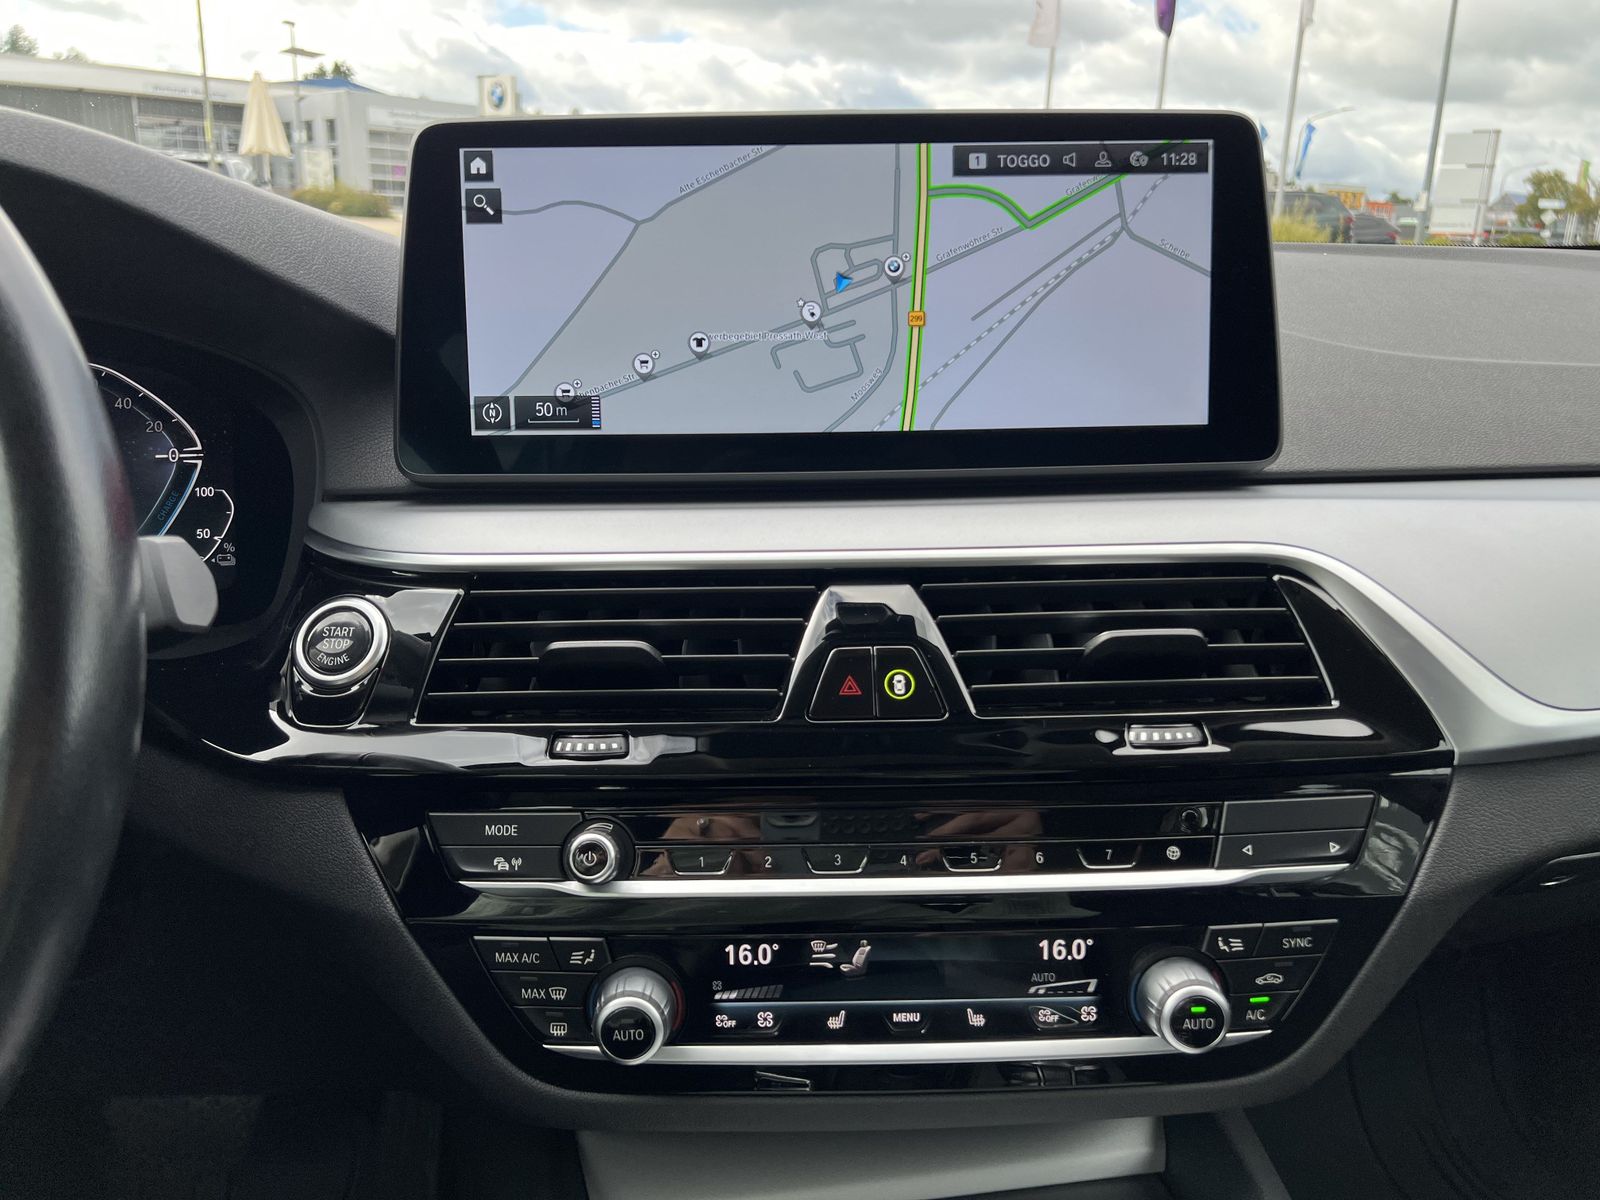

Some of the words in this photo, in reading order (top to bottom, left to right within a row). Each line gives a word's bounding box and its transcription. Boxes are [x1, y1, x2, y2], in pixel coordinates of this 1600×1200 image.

[997, 154, 1050, 168] TOGGO
[1160, 152, 1198, 166] 11:28
[679, 182, 695, 194] Alte
[695, 152, 751, 185] Eschenbacher
[1160, 238, 1191, 259] Scheibe
[909, 314, 923, 323] 299
[763, 331, 802, 341] Pressath
[850, 367, 883, 402] Moosweg
[114, 397, 132, 410] 40
[535, 402, 553, 416] 50
[555, 405, 568, 416] m
[488, 408, 497, 418] N
[145, 420, 163, 433] 20
[168, 448, 179, 463] 0
[194, 486, 215, 498] 100
[196, 528, 211, 540] 50
[322, 626, 356, 637] START
[322, 638, 351, 650] STOP
[316, 652, 351, 666] ENGINE
[484, 824, 518, 836] MODE
[834, 854, 842, 866] 3
[899, 855, 908, 867] 4
[969, 852, 978, 865] 5
[1035, 851, 1045, 865] 6
[1105, 849, 1113, 861] 7
[698, 856, 705, 868] 1
[764, 856, 773, 868] 2
[1282, 937, 1313, 949] SYNC
[724, 943, 780, 966] 16.0°
[1038, 938, 1095, 961] 16.0°
[495, 952, 519, 964] MAX
[521, 951, 540, 964] A/C
[1030, 972, 1056, 982] AUTO
[521, 988, 546, 1000] MAX
[893, 1012, 921, 1023] MENU
[1045, 1014, 1060, 1024] OFF
[1245, 1009, 1266, 1021] A/C
[723, 1018, 737, 1028] OFF
[1182, 1018, 1215, 1030] AUTO
[612, 1028, 644, 1041] AUTO
